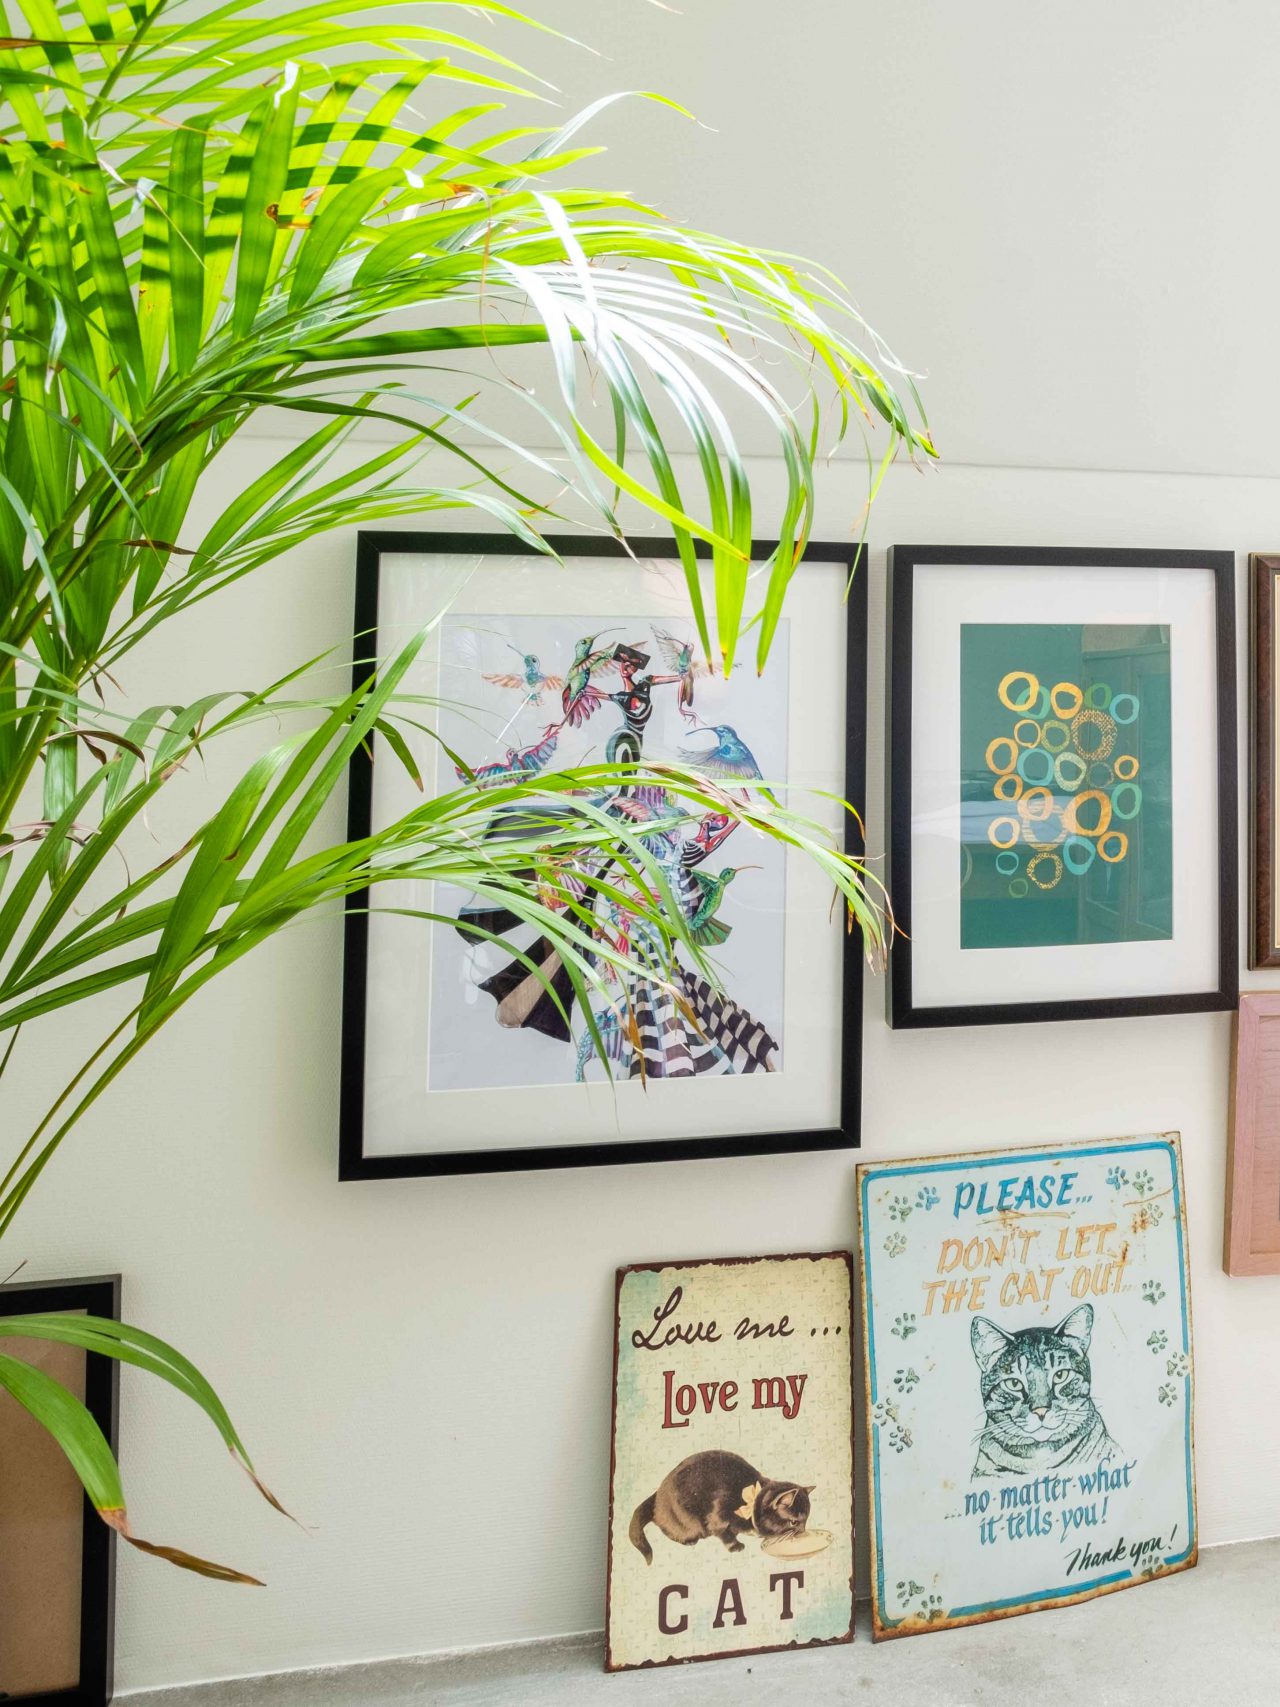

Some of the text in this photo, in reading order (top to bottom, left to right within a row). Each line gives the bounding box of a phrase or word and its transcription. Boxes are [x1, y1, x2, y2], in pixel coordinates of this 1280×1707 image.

[937, 1222, 1117, 1274] DON'T LET
[631, 1285, 722, 1351] Love
[734, 1315, 795, 1341] me
[922, 1275, 991, 1316] THE
[1000, 1266, 1064, 1307] CAT
[661, 1370, 808, 1429] Love my
[1000, 1473, 1073, 1511] matter
[1078, 1456, 1138, 1496] what
[979, 1496, 1109, 1546] it tells you!
[1064, 1523, 1178, 1576] Thank you!
[658, 1570, 805, 1636] CAT
